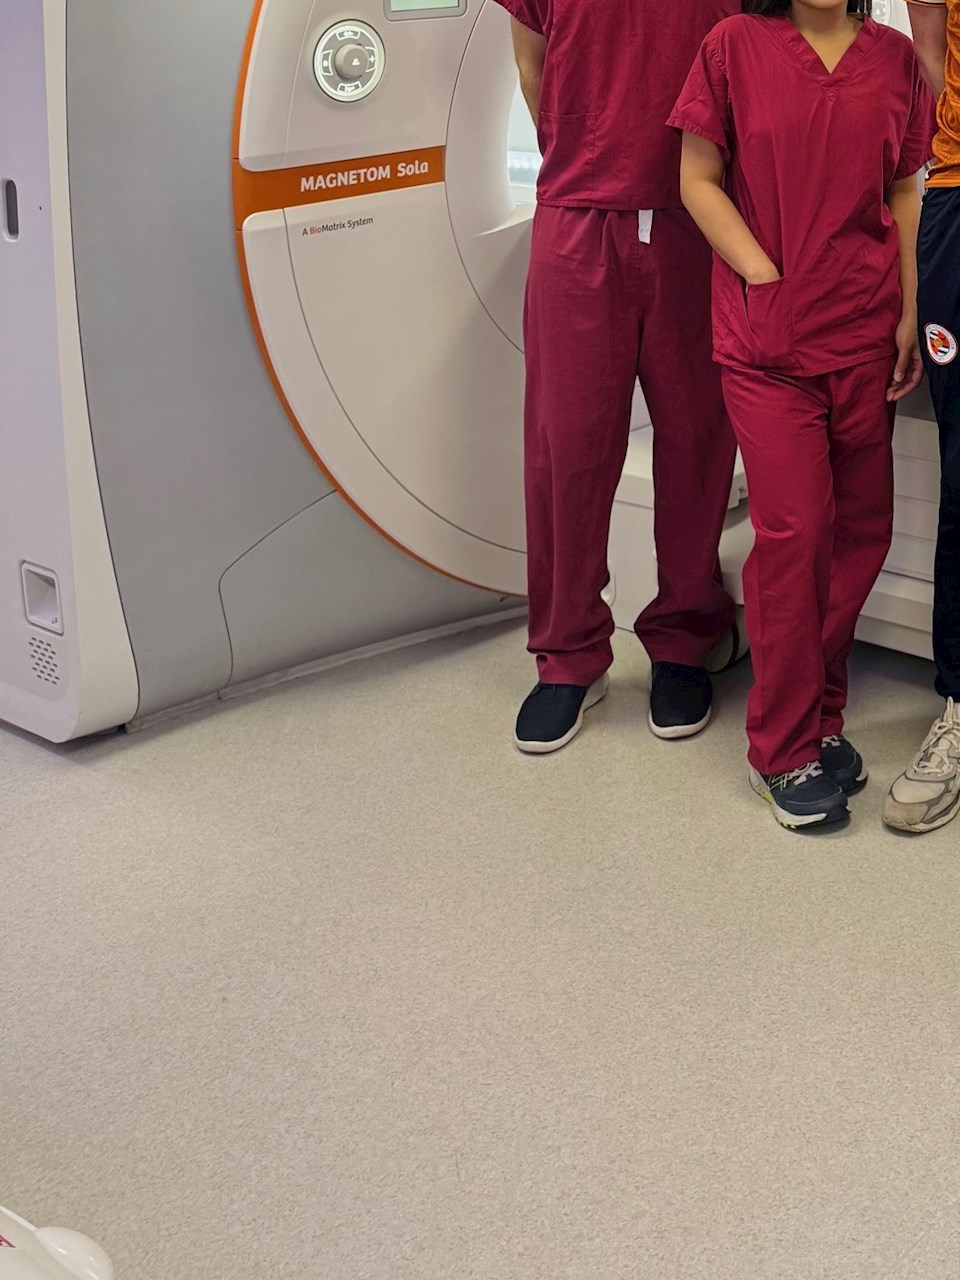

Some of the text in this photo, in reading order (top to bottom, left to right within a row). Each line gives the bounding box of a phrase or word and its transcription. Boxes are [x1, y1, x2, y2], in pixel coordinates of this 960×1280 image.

[300, 160, 429, 192] MAGNETOM Sola
[302, 217, 374, 236] A BioMatrix System
